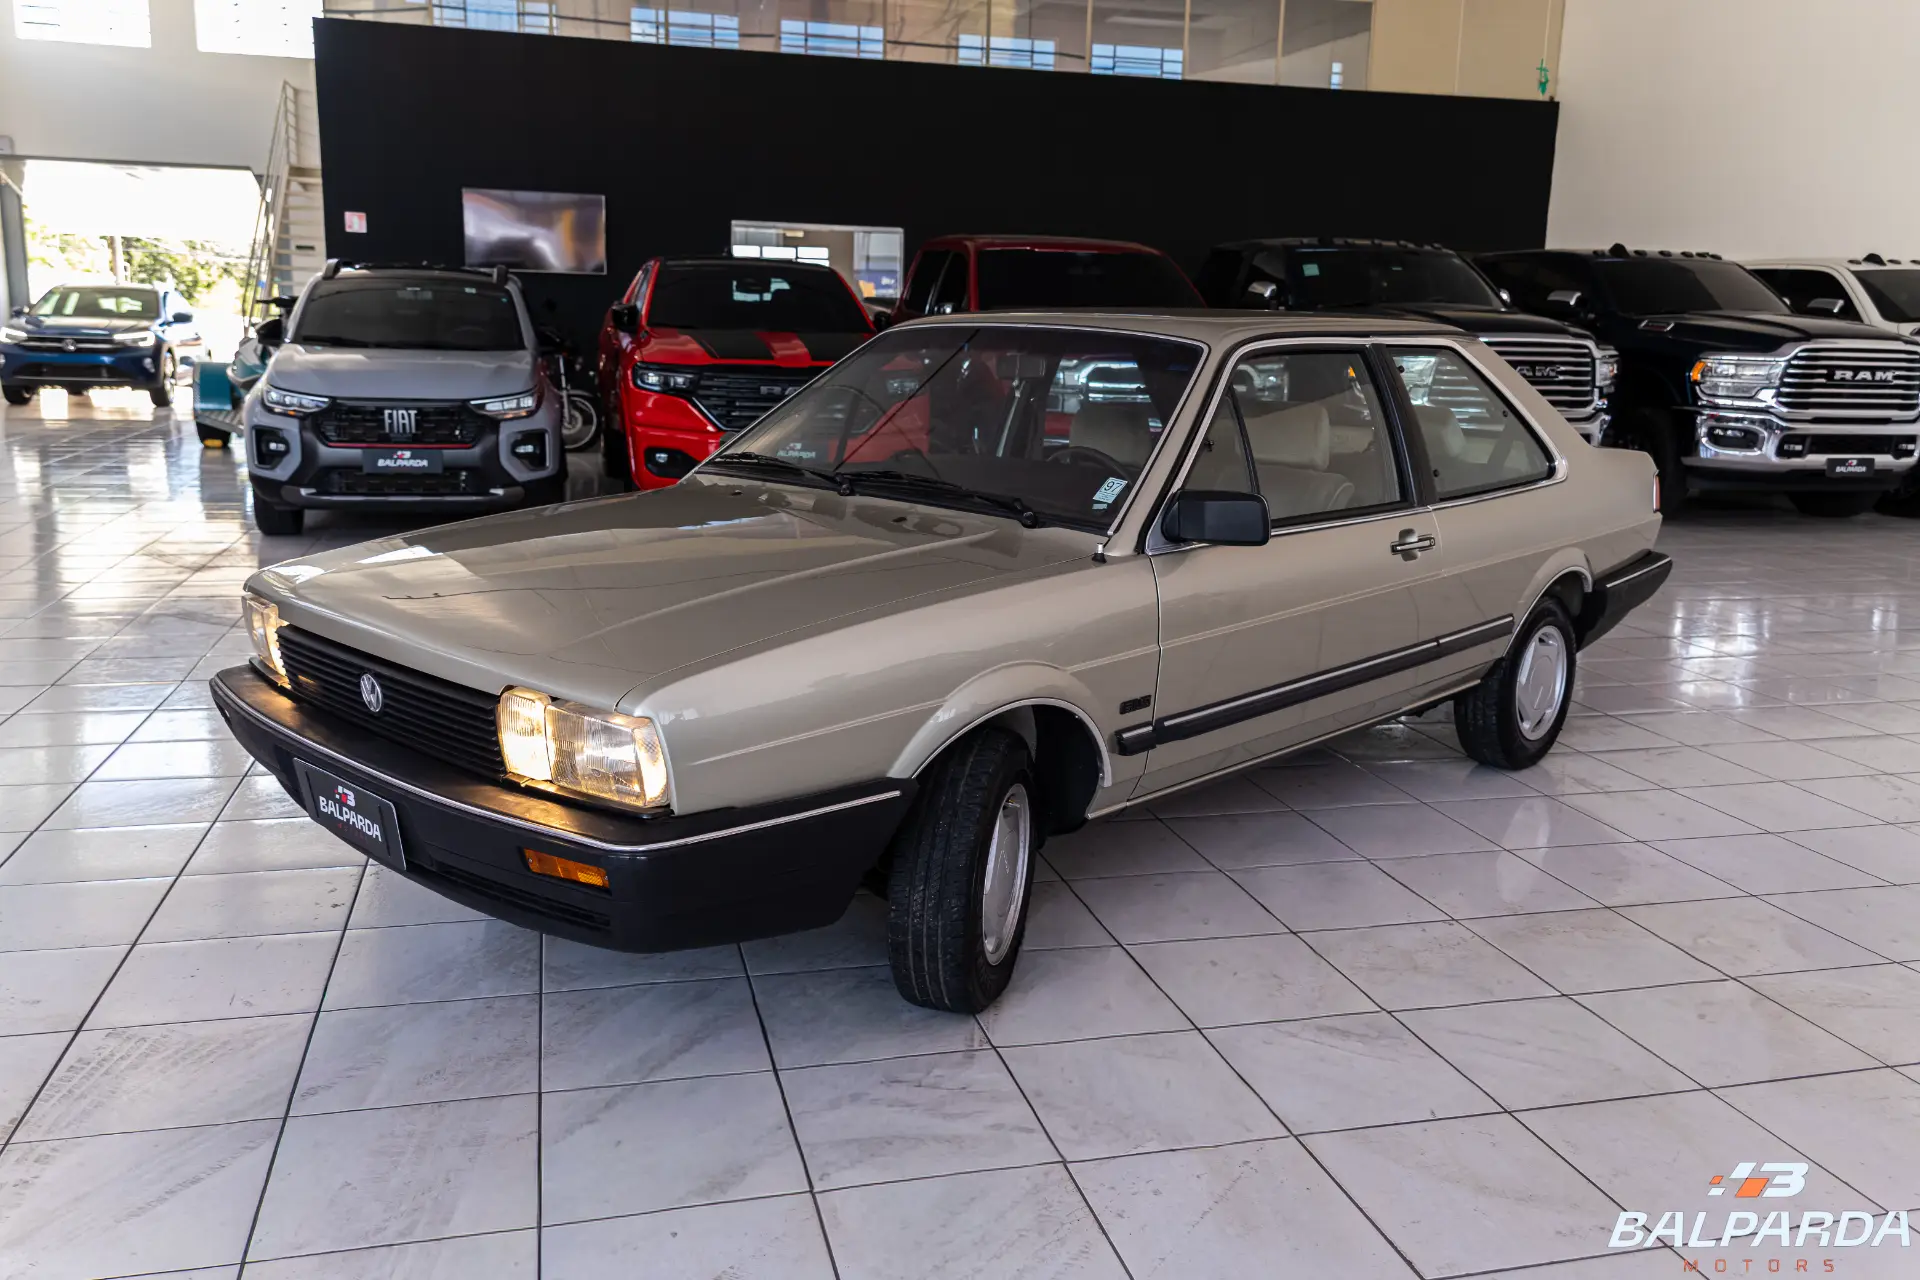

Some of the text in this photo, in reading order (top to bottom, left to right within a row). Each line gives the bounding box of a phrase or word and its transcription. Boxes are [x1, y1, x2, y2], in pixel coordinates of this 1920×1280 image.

[1515, 366, 1557, 376] AM
[1834, 370, 1895, 380] RAM
[760, 386, 802, 395] RA
[383, 409, 417, 434] FIAT
[377, 459, 429, 467] BALPARDA
[1104, 481, 1123, 492] 97
[319, 795, 382, 842] BALPARDA
